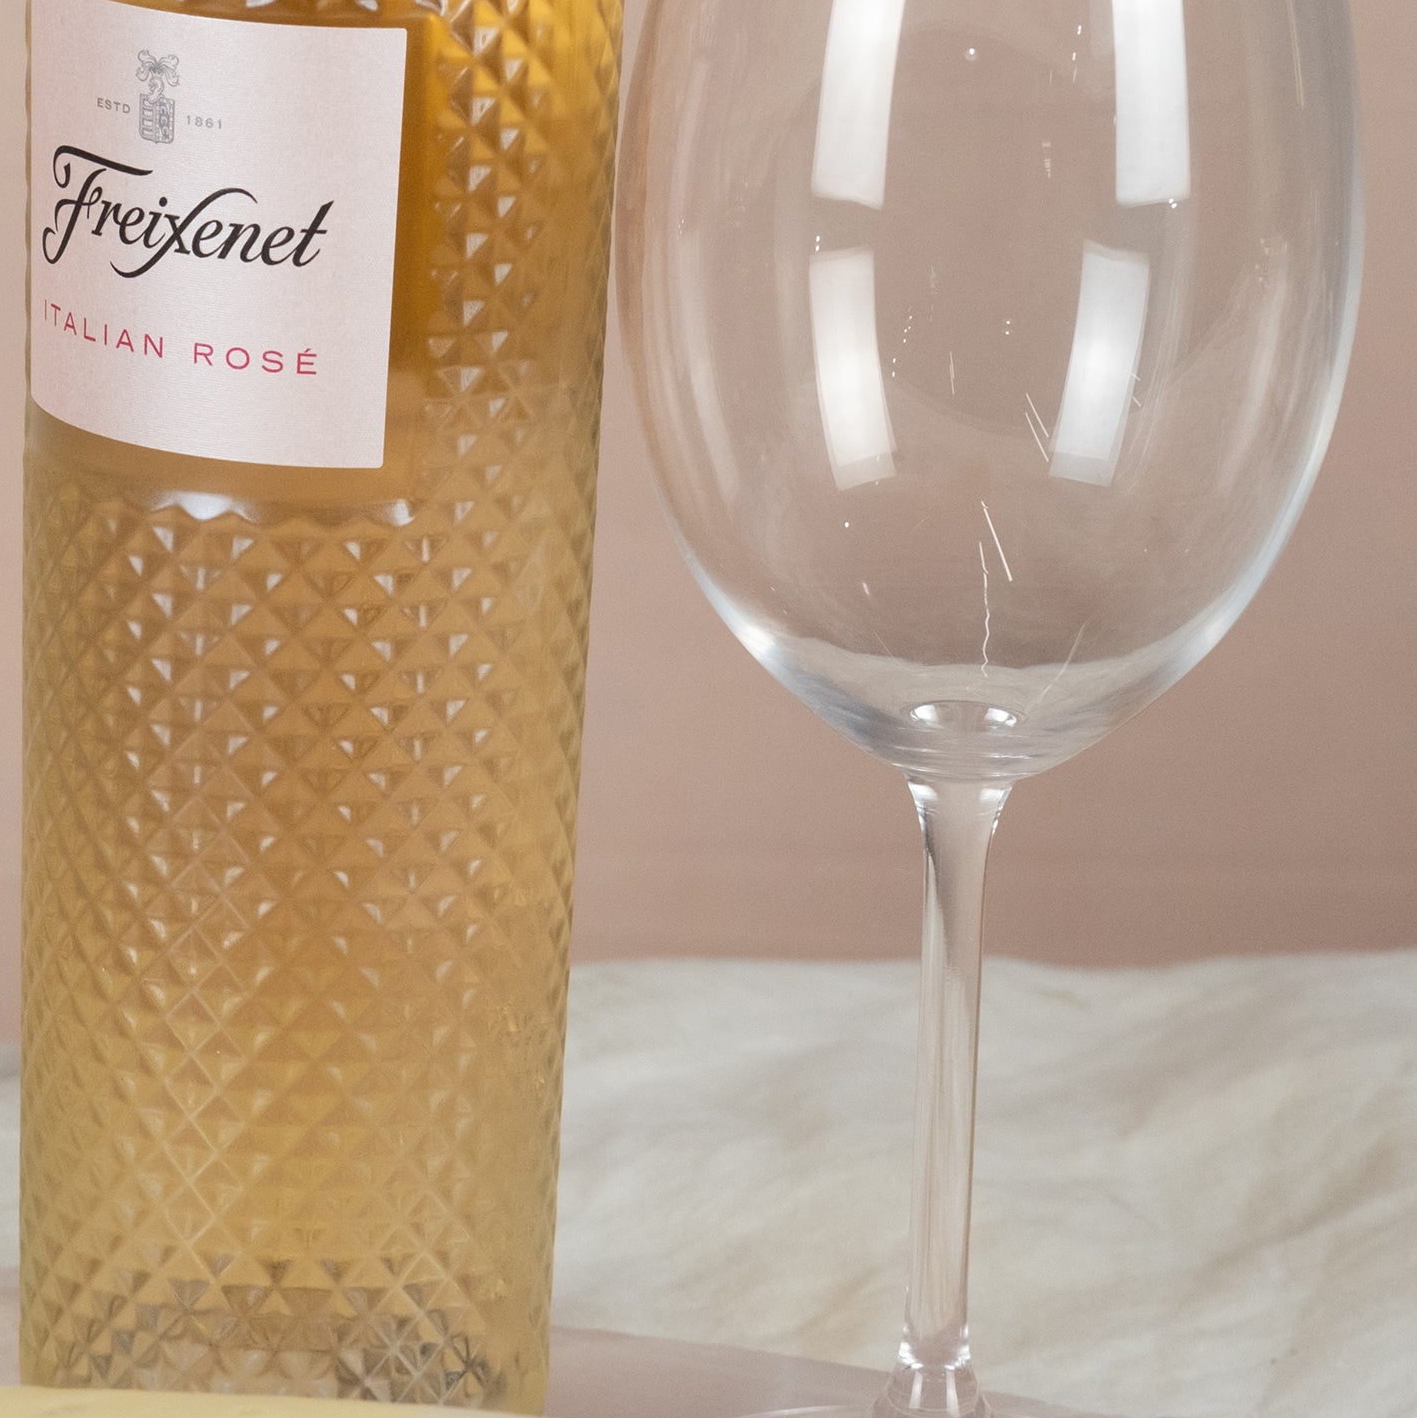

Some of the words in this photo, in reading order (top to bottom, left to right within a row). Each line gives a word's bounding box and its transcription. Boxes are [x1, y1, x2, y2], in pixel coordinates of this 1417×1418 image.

[96, 97, 131, 114] ESTD
[186, 115, 222, 129] 1861
[42, 144, 335, 279] Freixenet
[44, 298, 165, 359] ITALIAN
[192, 342, 318, 376] ROSÉ
